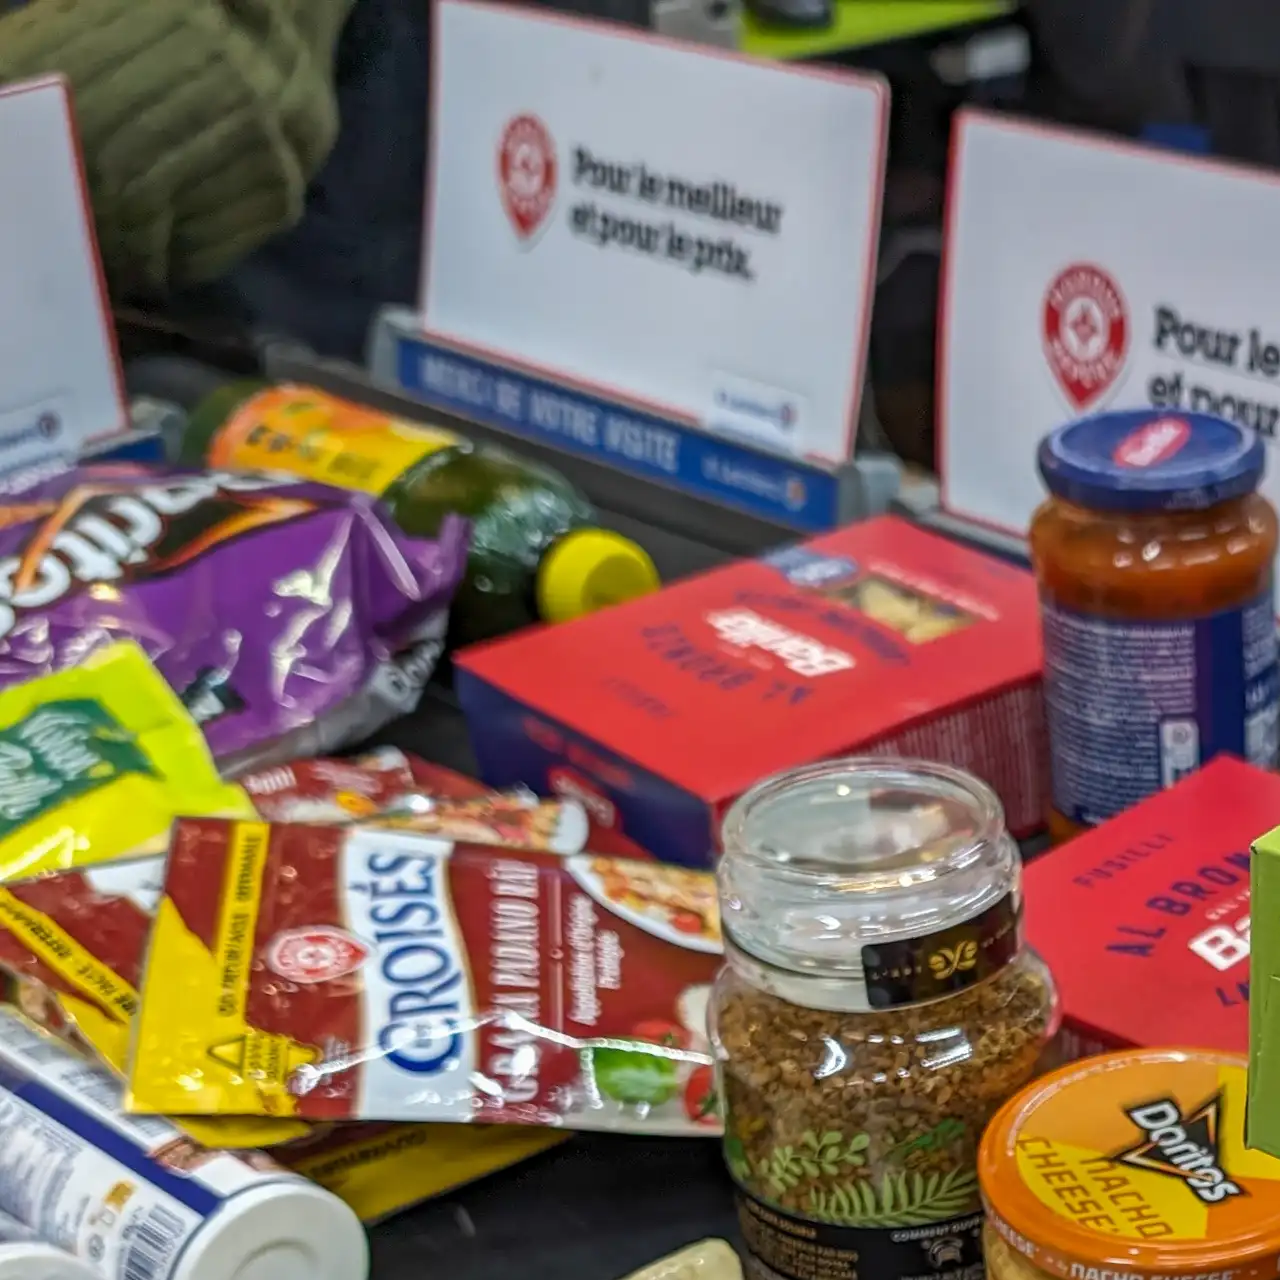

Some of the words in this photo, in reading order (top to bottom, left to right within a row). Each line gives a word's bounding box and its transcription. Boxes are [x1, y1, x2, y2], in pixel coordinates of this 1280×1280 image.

[572, 143, 630, 186] Pour
[638, 162, 663, 196] le
[664, 174, 784, 235] meilleur
[569, 204, 597, 239] et
[597, 214, 660, 255] pour
[666, 222, 695, 259] le
[695, 233, 756, 283] prix.
[1153, 303, 1240, 362] Pour
[1149, 374, 1183, 410] et
[1073, 832, 1175, 889] FUSILLI
[348, 842, 463, 1080] CROISÉS
[487, 894, 539, 988] PADANO
[1106, 924, 1166, 957] AL
[1017, 1136, 1118, 1234] CHEESE
[1128, 1099, 1239, 1202] Doritos
[1081, 1157, 1174, 1239] NACHO
